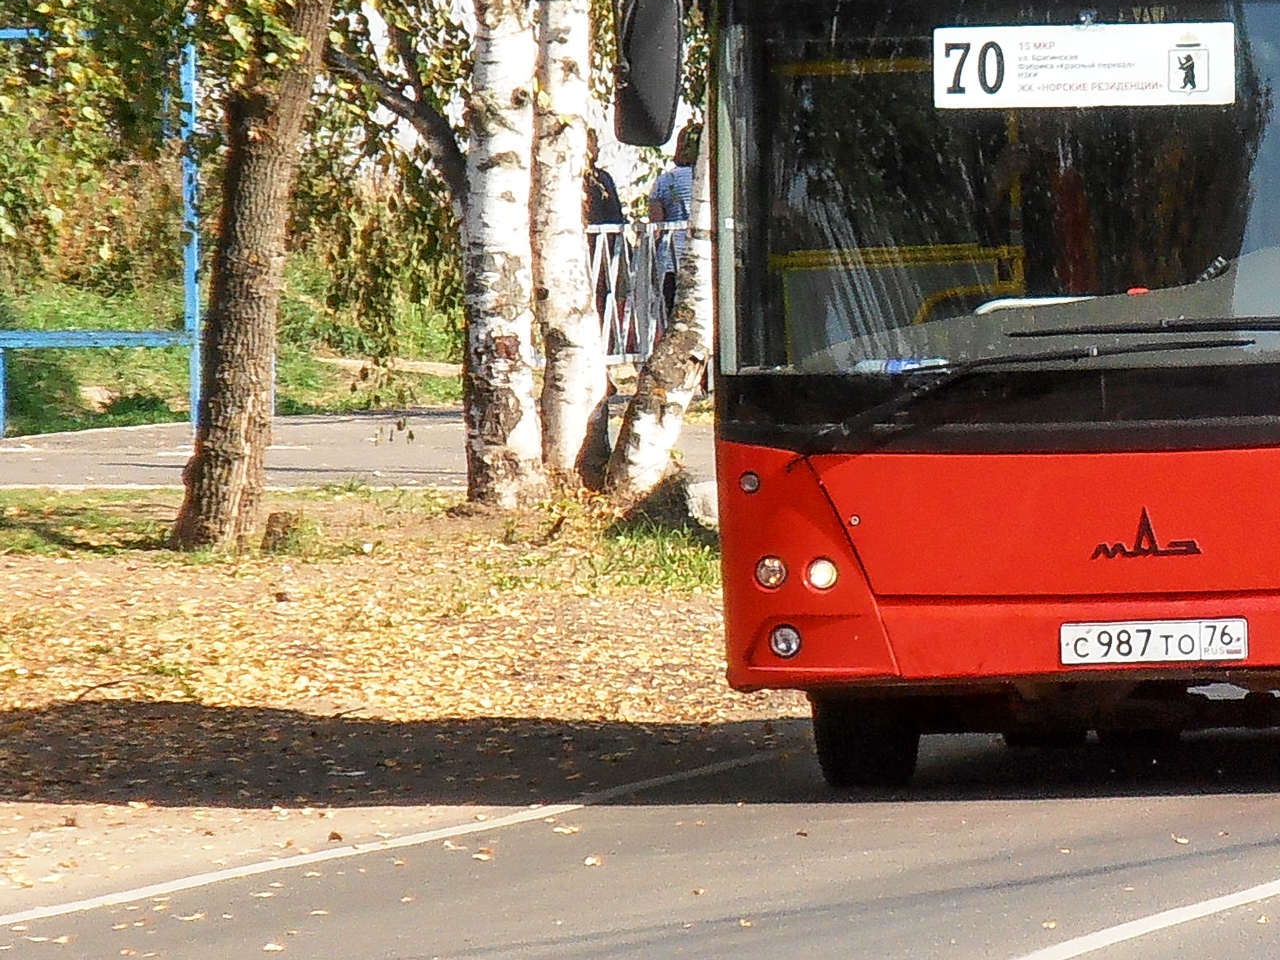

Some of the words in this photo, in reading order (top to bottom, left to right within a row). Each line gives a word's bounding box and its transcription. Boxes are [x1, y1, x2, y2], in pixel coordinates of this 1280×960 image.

[1033, 41, 1056, 50] МКР
[944, 41, 1005, 95] 70
[1037, 82, 1088, 92] «НОРСКИЕ
[1091, 81, 1163, 92] РЕЗИДЕНЦИИ»
[1204, 625, 1233, 646] 76
[1203, 647, 1225, 655] RUS
